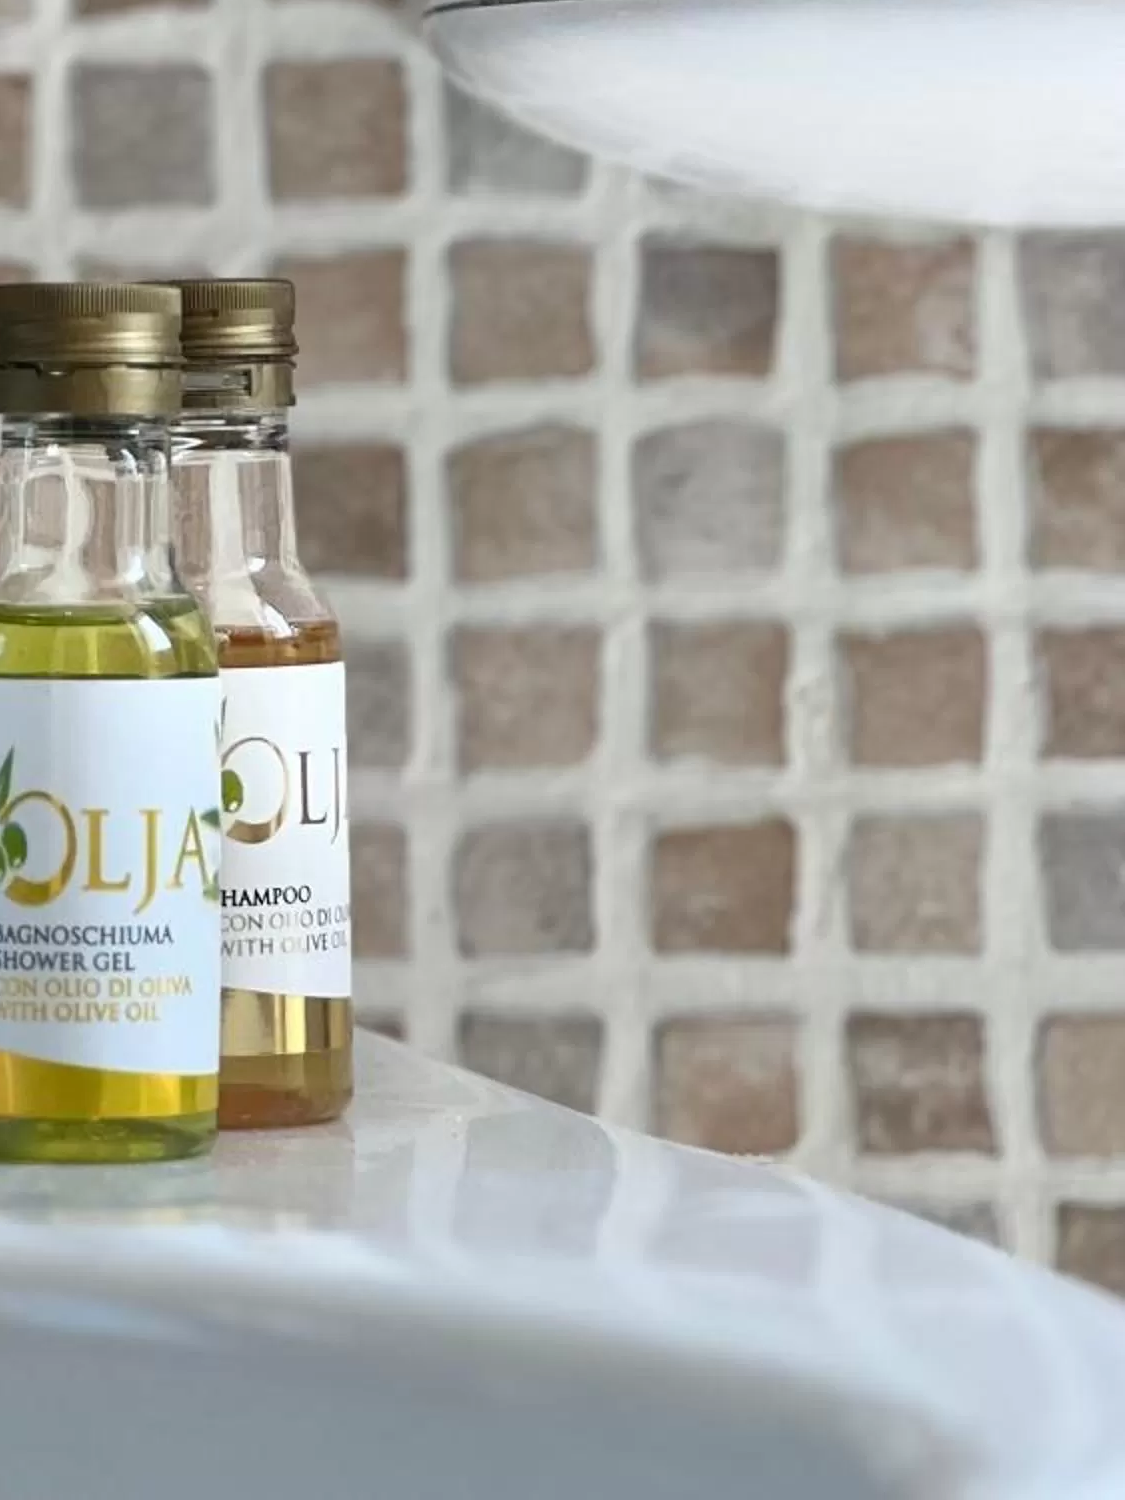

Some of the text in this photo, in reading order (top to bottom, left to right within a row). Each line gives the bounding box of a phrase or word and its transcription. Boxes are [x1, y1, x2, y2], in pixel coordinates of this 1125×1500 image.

[221, 737, 341, 845] OLJ
[220, 885, 312, 907] HAMPOO
[92, 951, 136, 972] GEL
[43, 976, 102, 998] OLIO
[109, 977, 133, 998] DI
[139, 975, 194, 998] OLIVA
[52, 1002, 120, 1023] OLIVE
[125, 1001, 162, 1023] OIL
